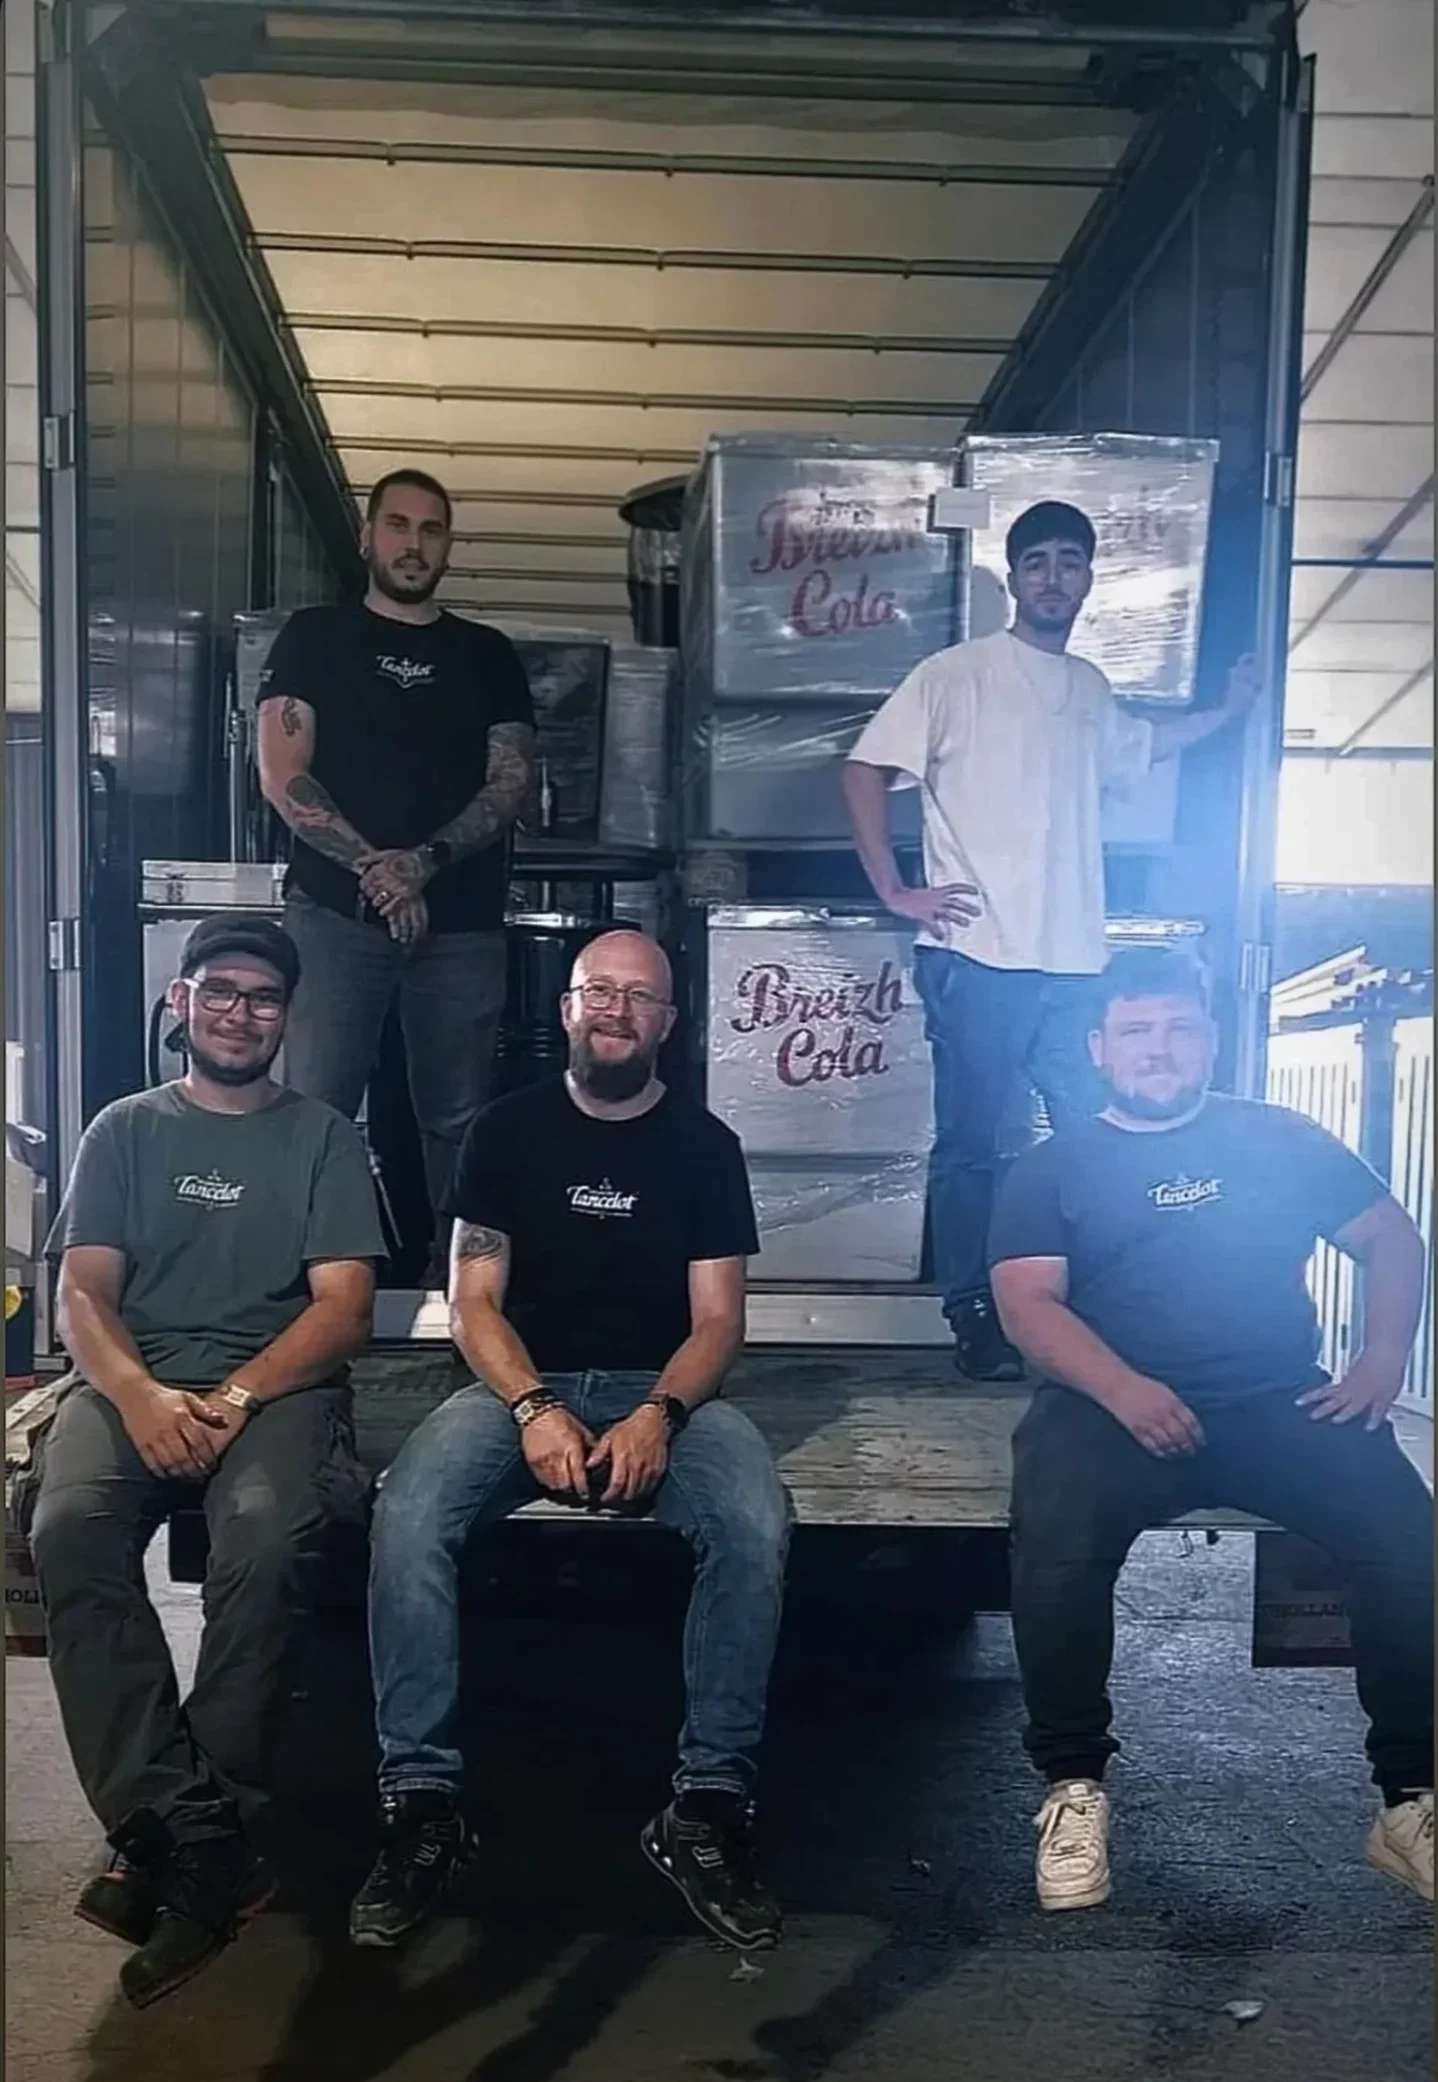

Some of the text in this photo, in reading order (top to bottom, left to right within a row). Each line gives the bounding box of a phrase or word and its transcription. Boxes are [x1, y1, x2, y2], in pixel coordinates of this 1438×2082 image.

[789, 569, 900, 638] Cola
[730, 961, 903, 1034] Breizh
[776, 1027, 890, 1088] Cola
